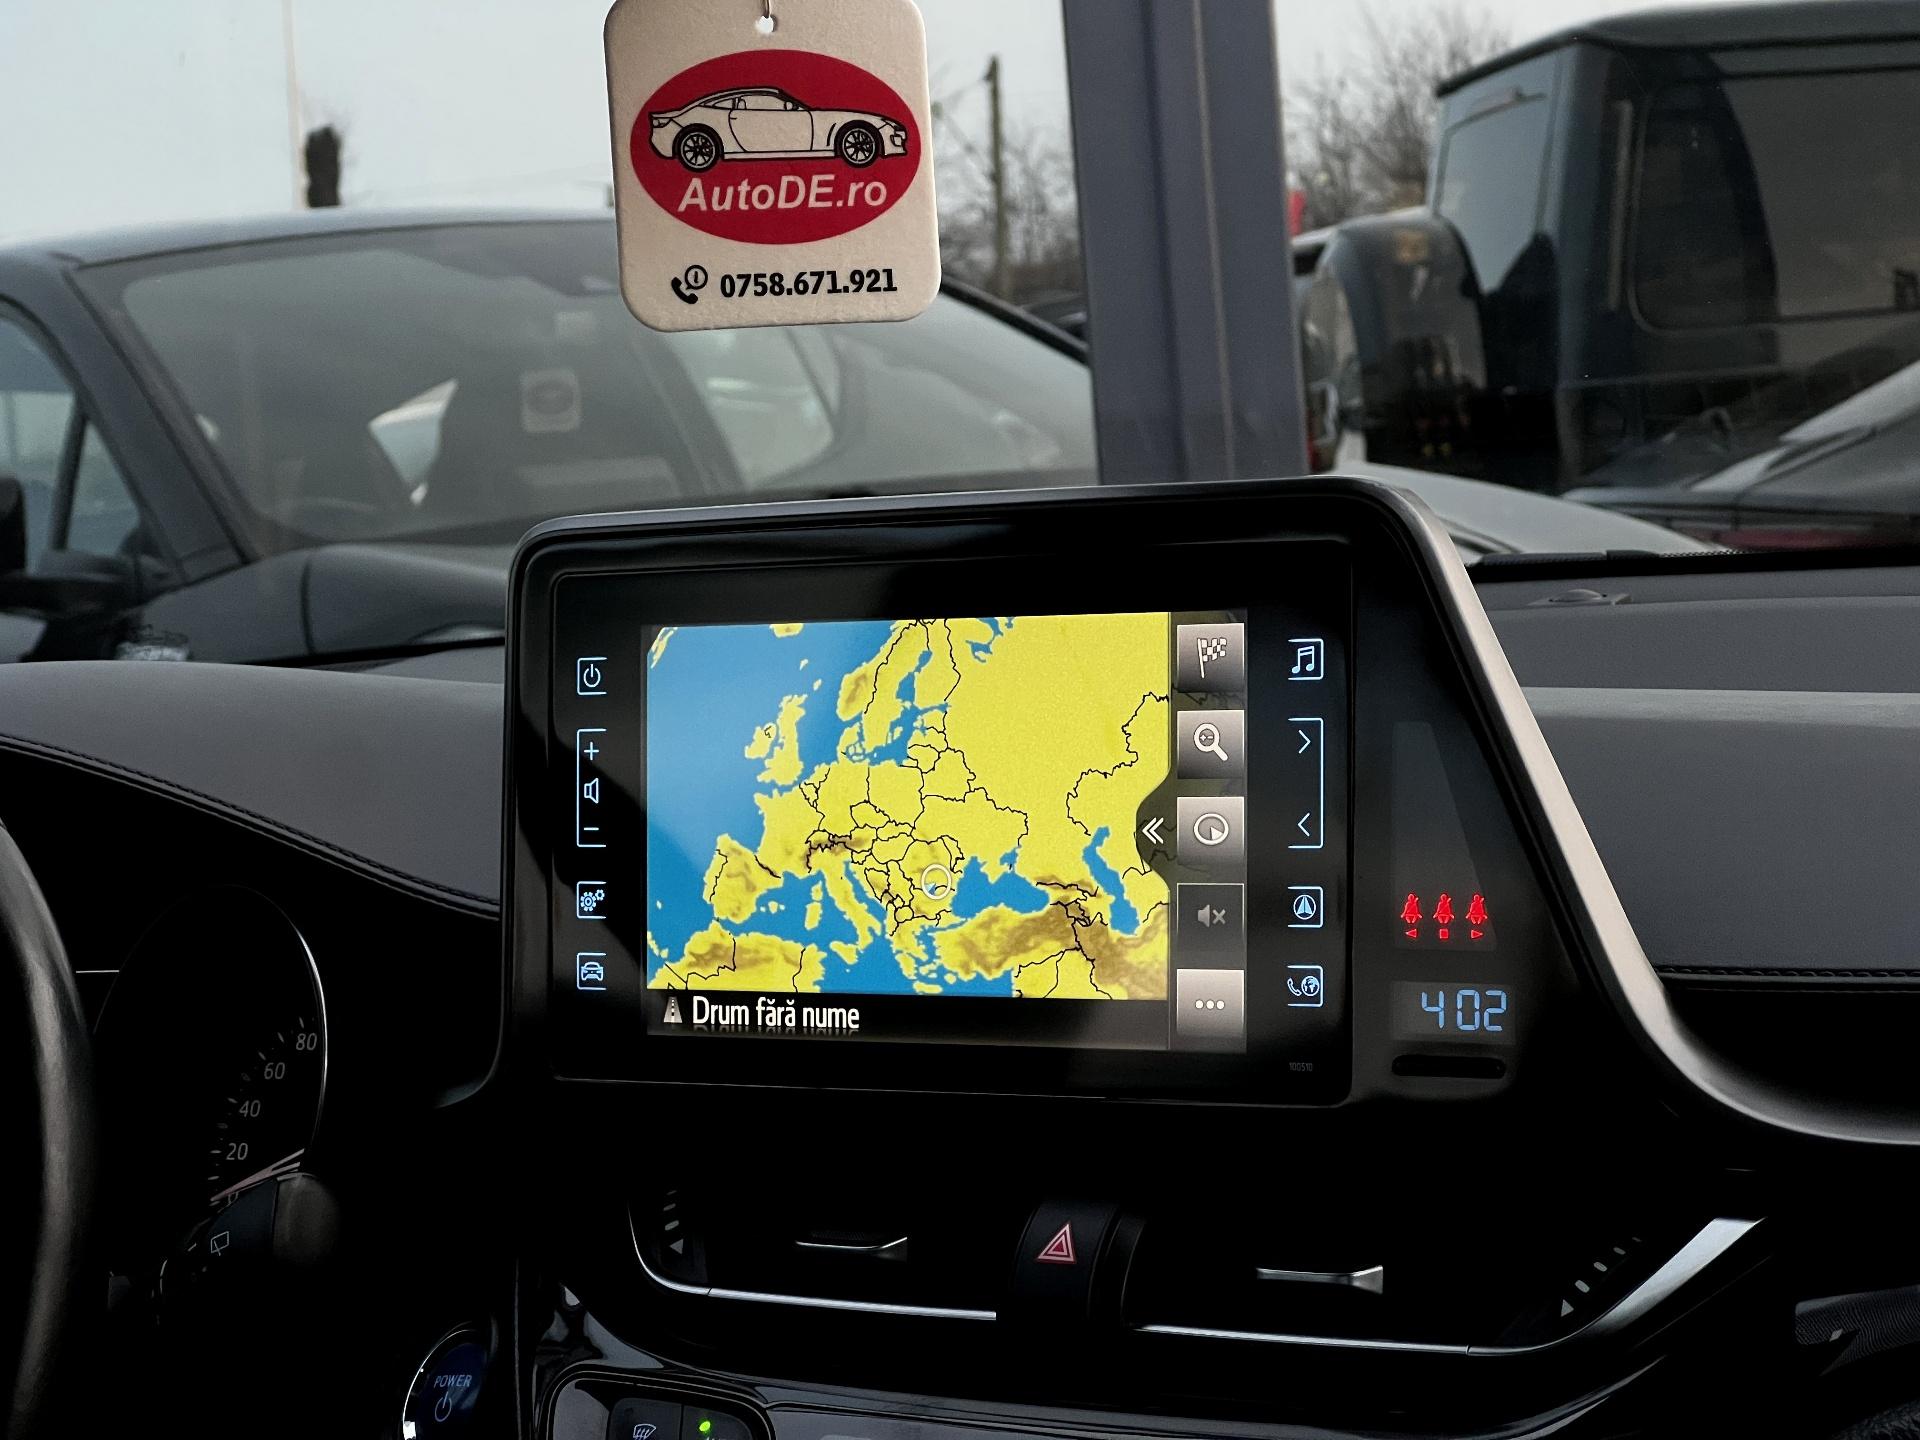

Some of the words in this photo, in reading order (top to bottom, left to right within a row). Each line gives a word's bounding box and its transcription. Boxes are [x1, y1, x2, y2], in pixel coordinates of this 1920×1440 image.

[677, 173, 888, 213] AutoDE.ro
[720, 268, 898, 297] 0758.671.921
[692, 995, 750, 1026] Drum
[755, 996, 796, 1027] fără
[802, 1006, 860, 1029] nume
[1421, 989, 1508, 1032] 402
[295, 1032, 318, 1051] 80
[264, 1062, 286, 1080] 60
[238, 1099, 261, 1118] 40
[225, 1142, 249, 1161] 20
[433, 1374, 473, 1389] POWER
